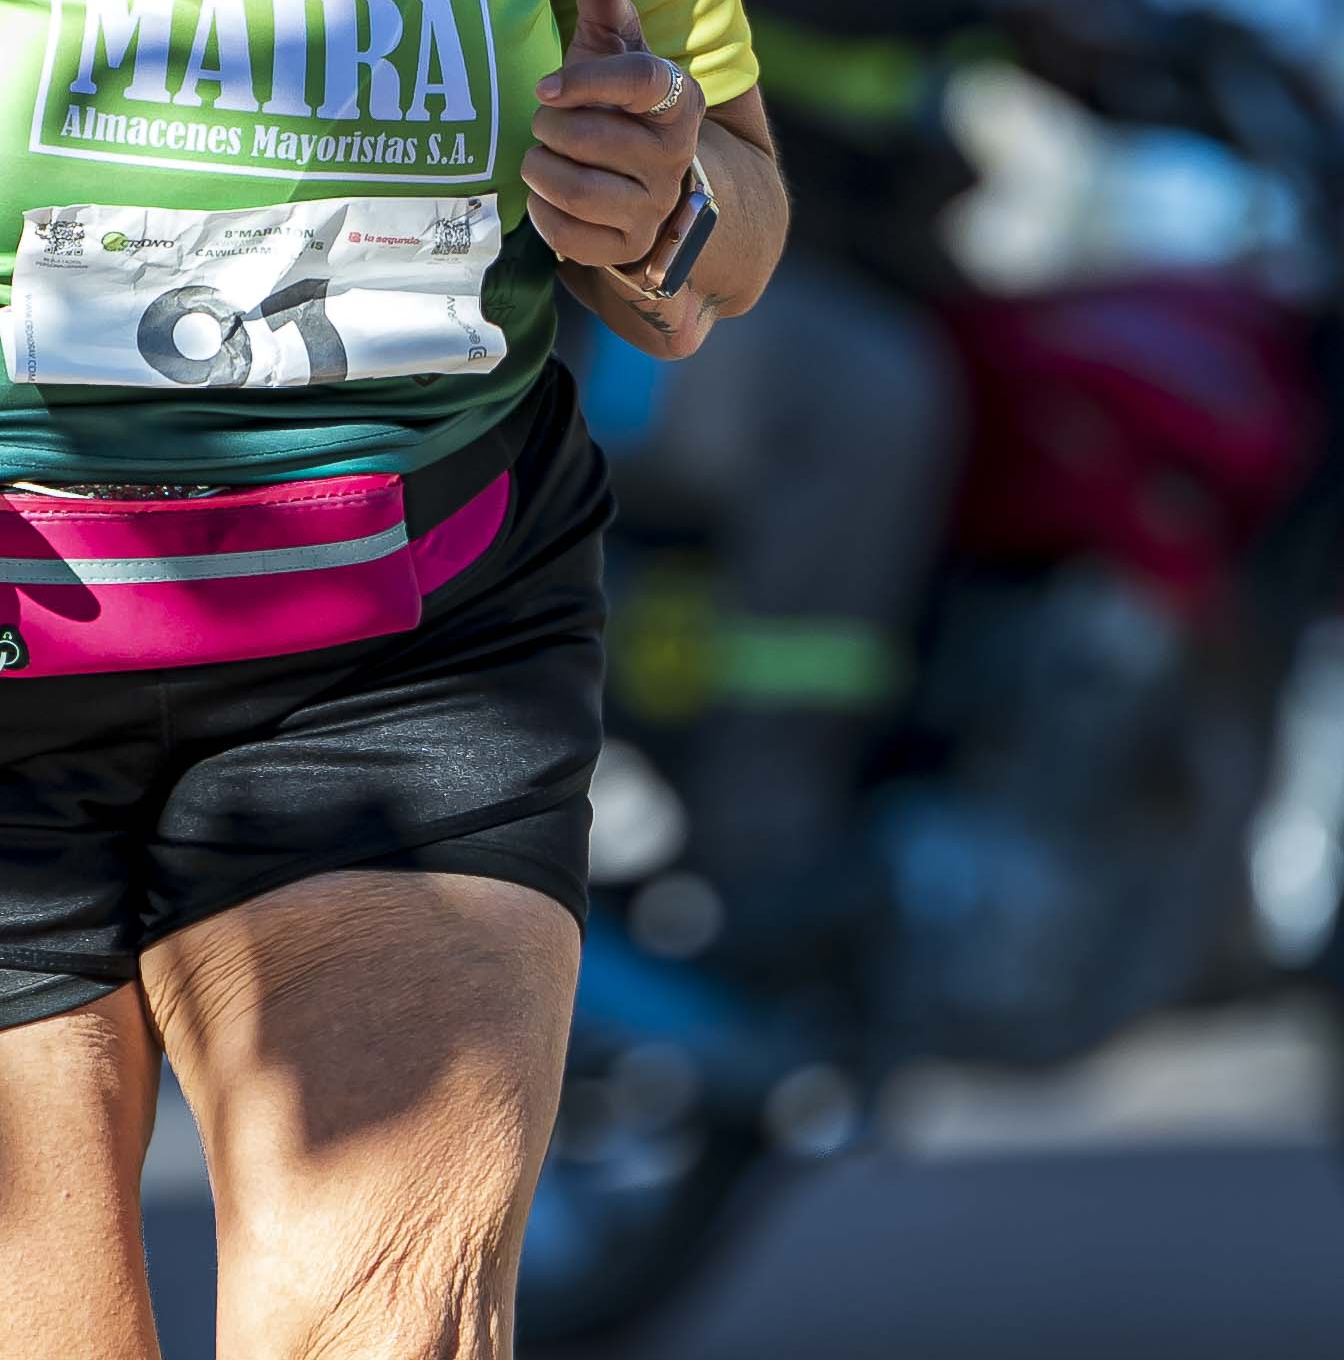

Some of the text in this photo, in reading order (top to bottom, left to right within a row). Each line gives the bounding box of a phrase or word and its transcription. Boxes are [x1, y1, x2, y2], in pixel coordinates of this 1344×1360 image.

[61, 104, 475, 166] Almacenes Mayoristas S.A.
